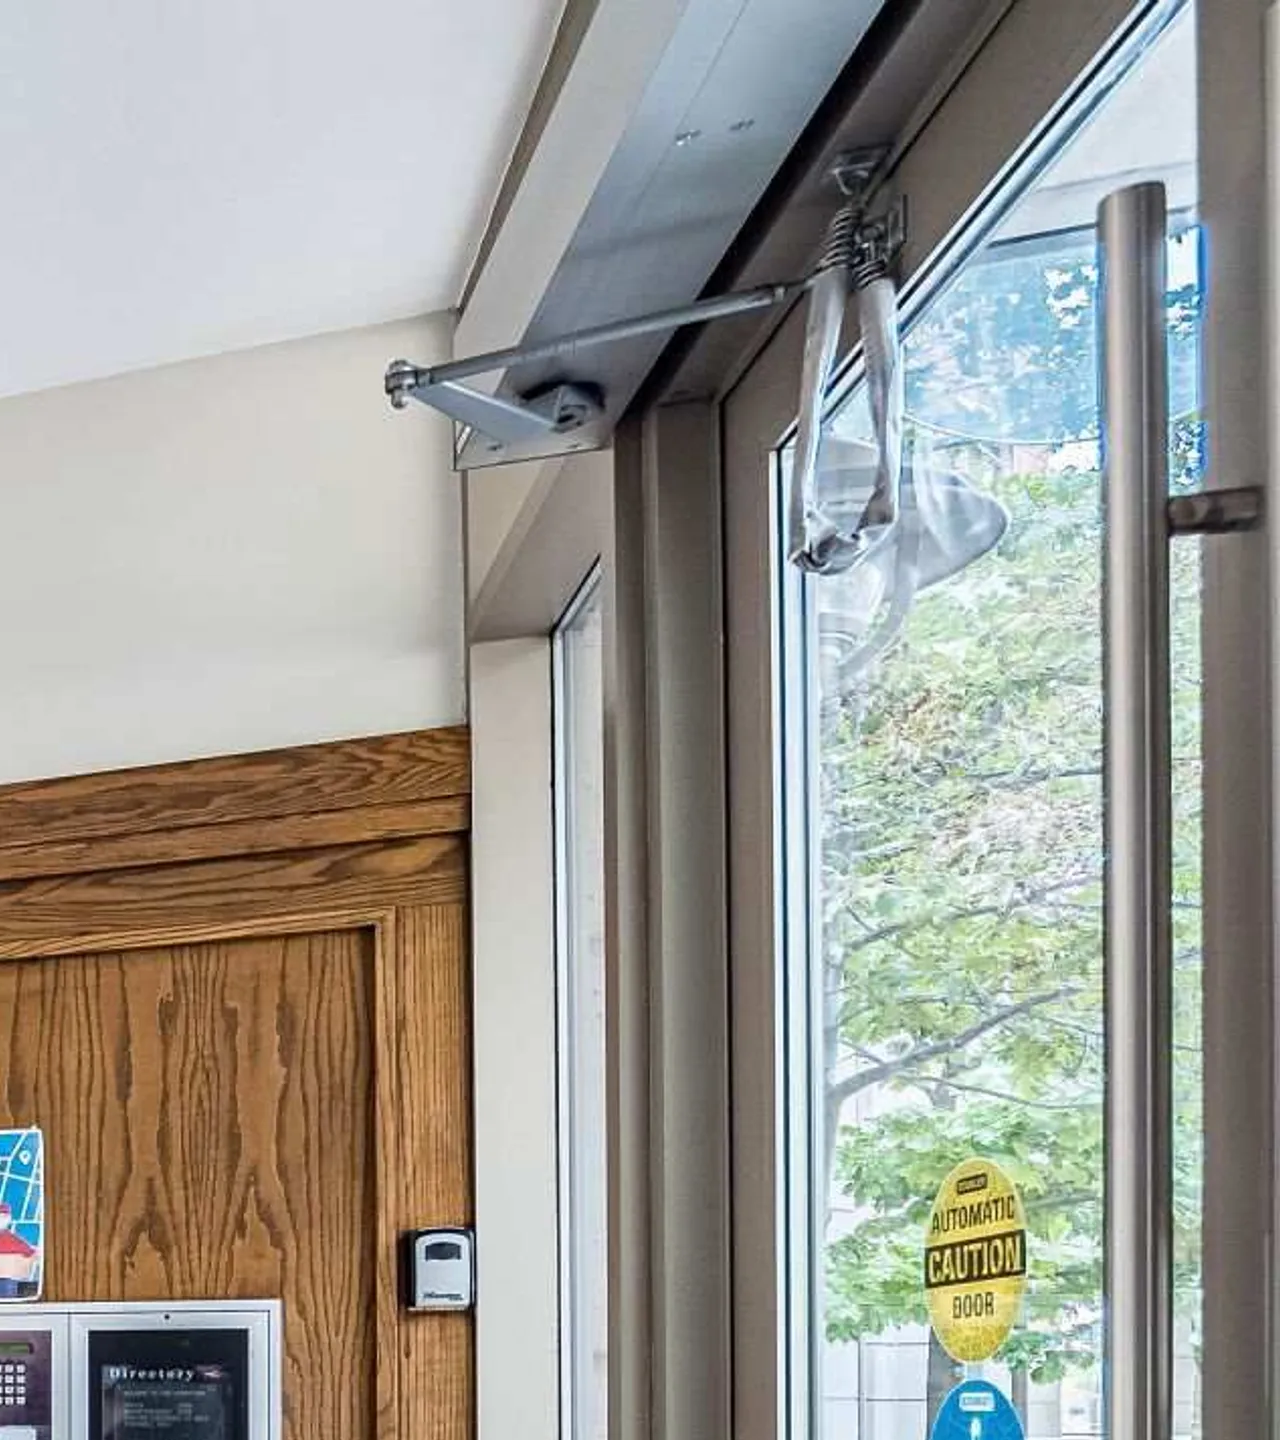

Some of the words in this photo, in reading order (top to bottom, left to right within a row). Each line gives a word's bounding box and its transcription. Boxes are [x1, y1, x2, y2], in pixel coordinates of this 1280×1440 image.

[932, 1194, 1015, 1232] AUTOMATIC
[928, 1234, 1022, 1284] CAUTION
[953, 1291, 995, 1319] DOOR
[109, 1366, 195, 1382] Directory
